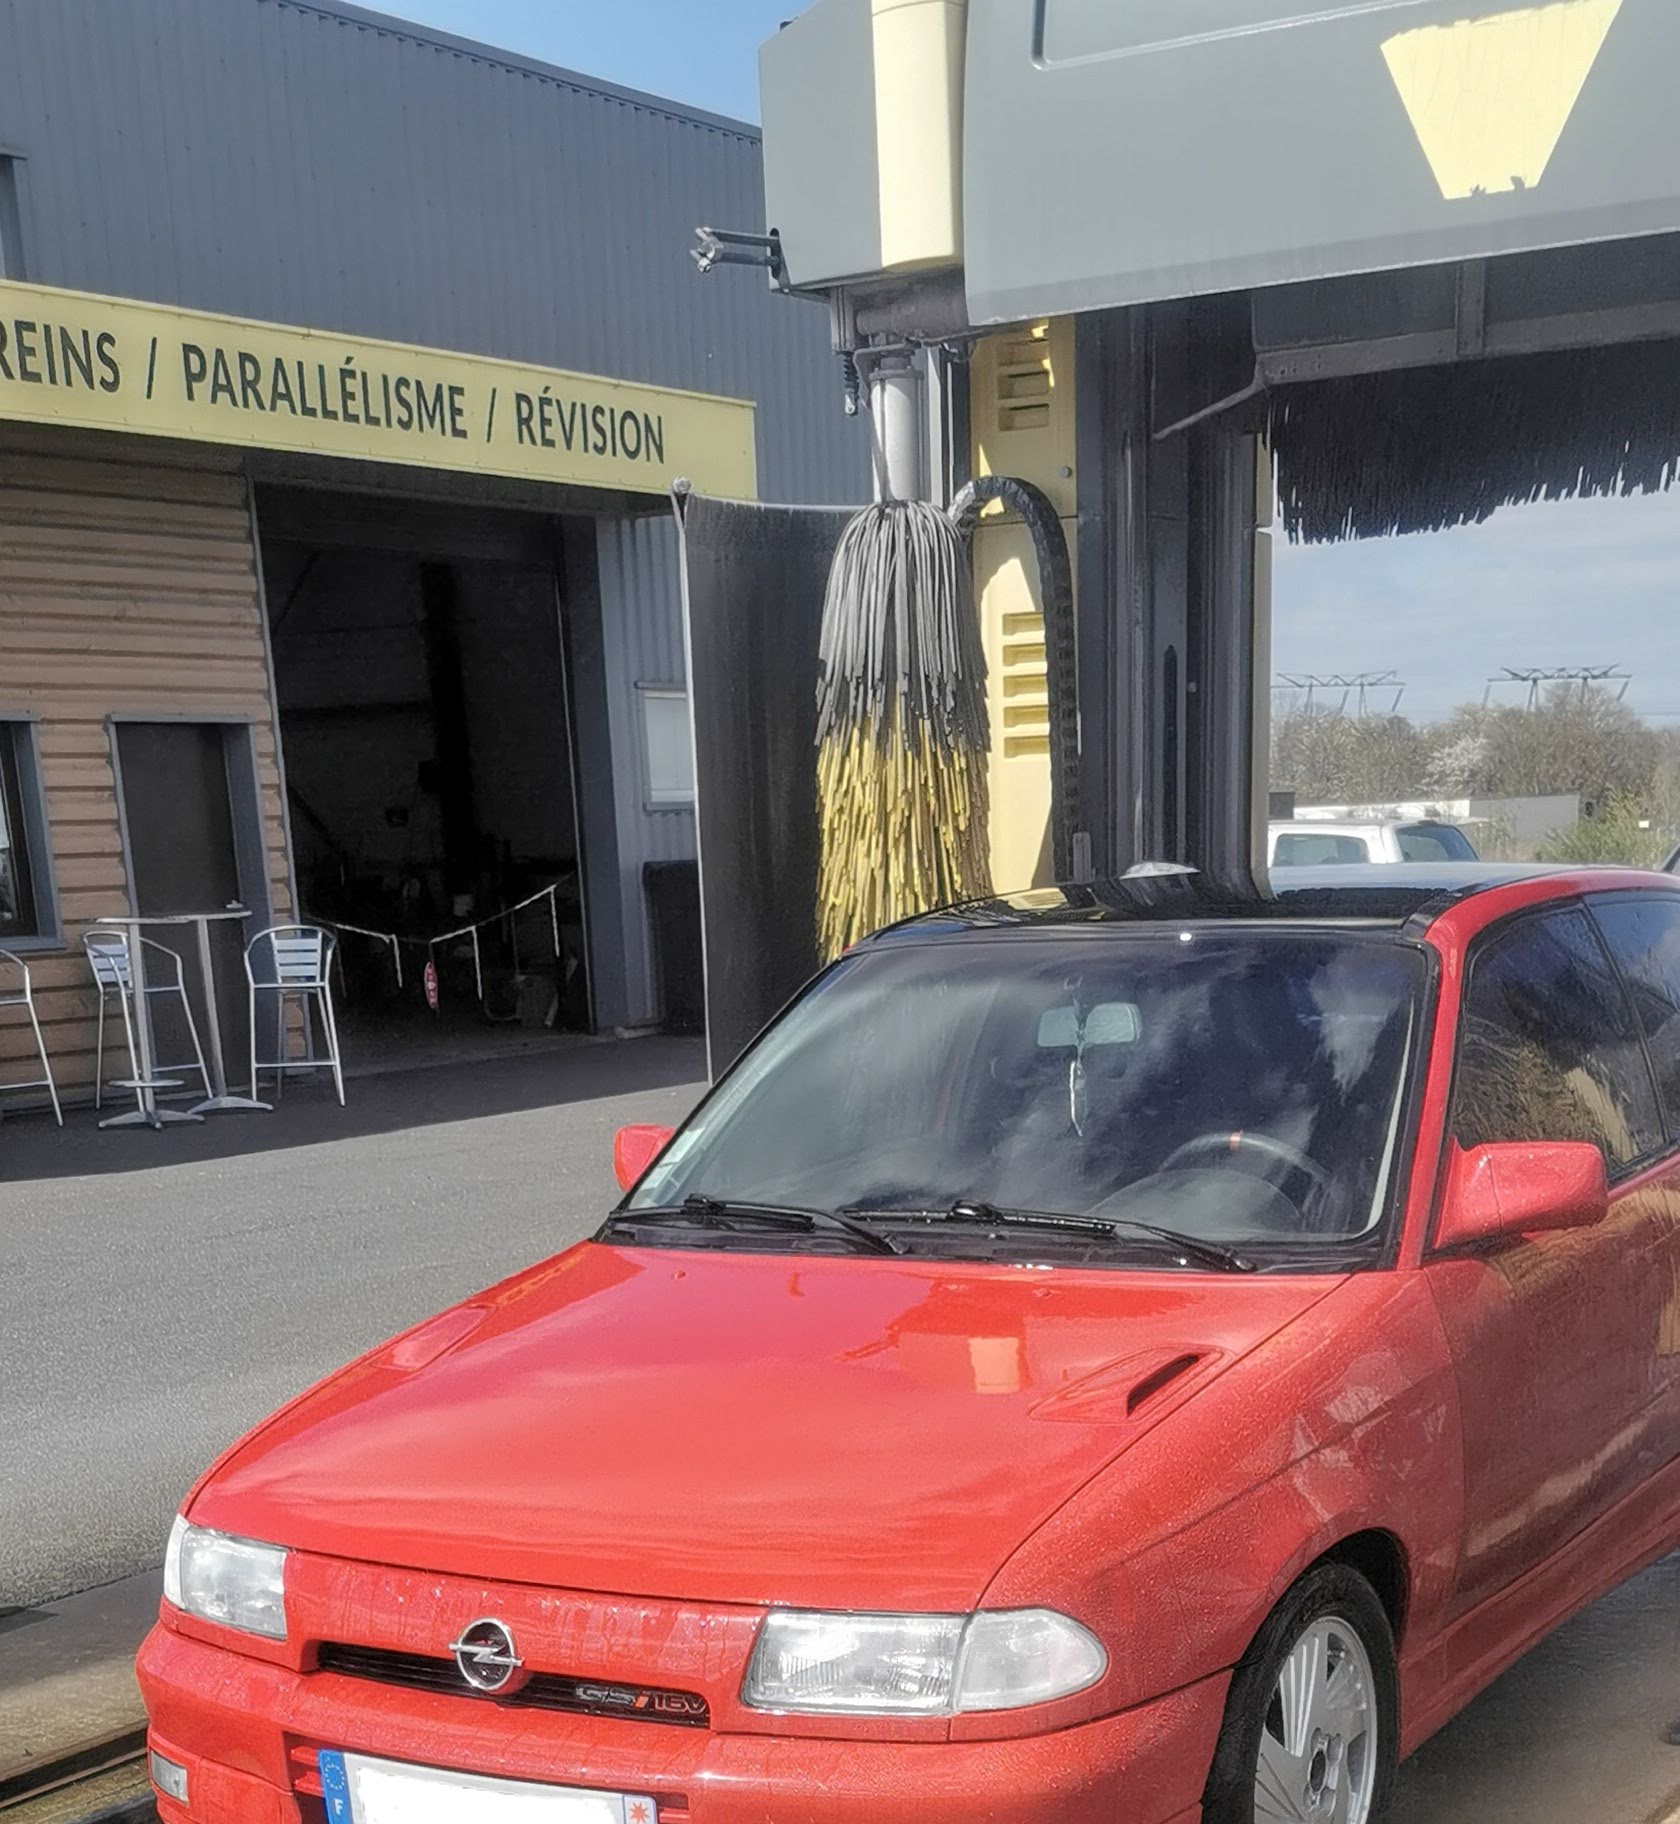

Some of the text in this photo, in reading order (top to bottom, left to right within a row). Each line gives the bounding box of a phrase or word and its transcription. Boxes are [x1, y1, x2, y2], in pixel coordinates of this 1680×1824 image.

[145, 336, 158, 400] /
[181, 343, 468, 440] PARALLÉLISME
[486, 387, 498, 444] /
[515, 386, 665, 465] RÉVISION
[333, 1797, 344, 1816] F
